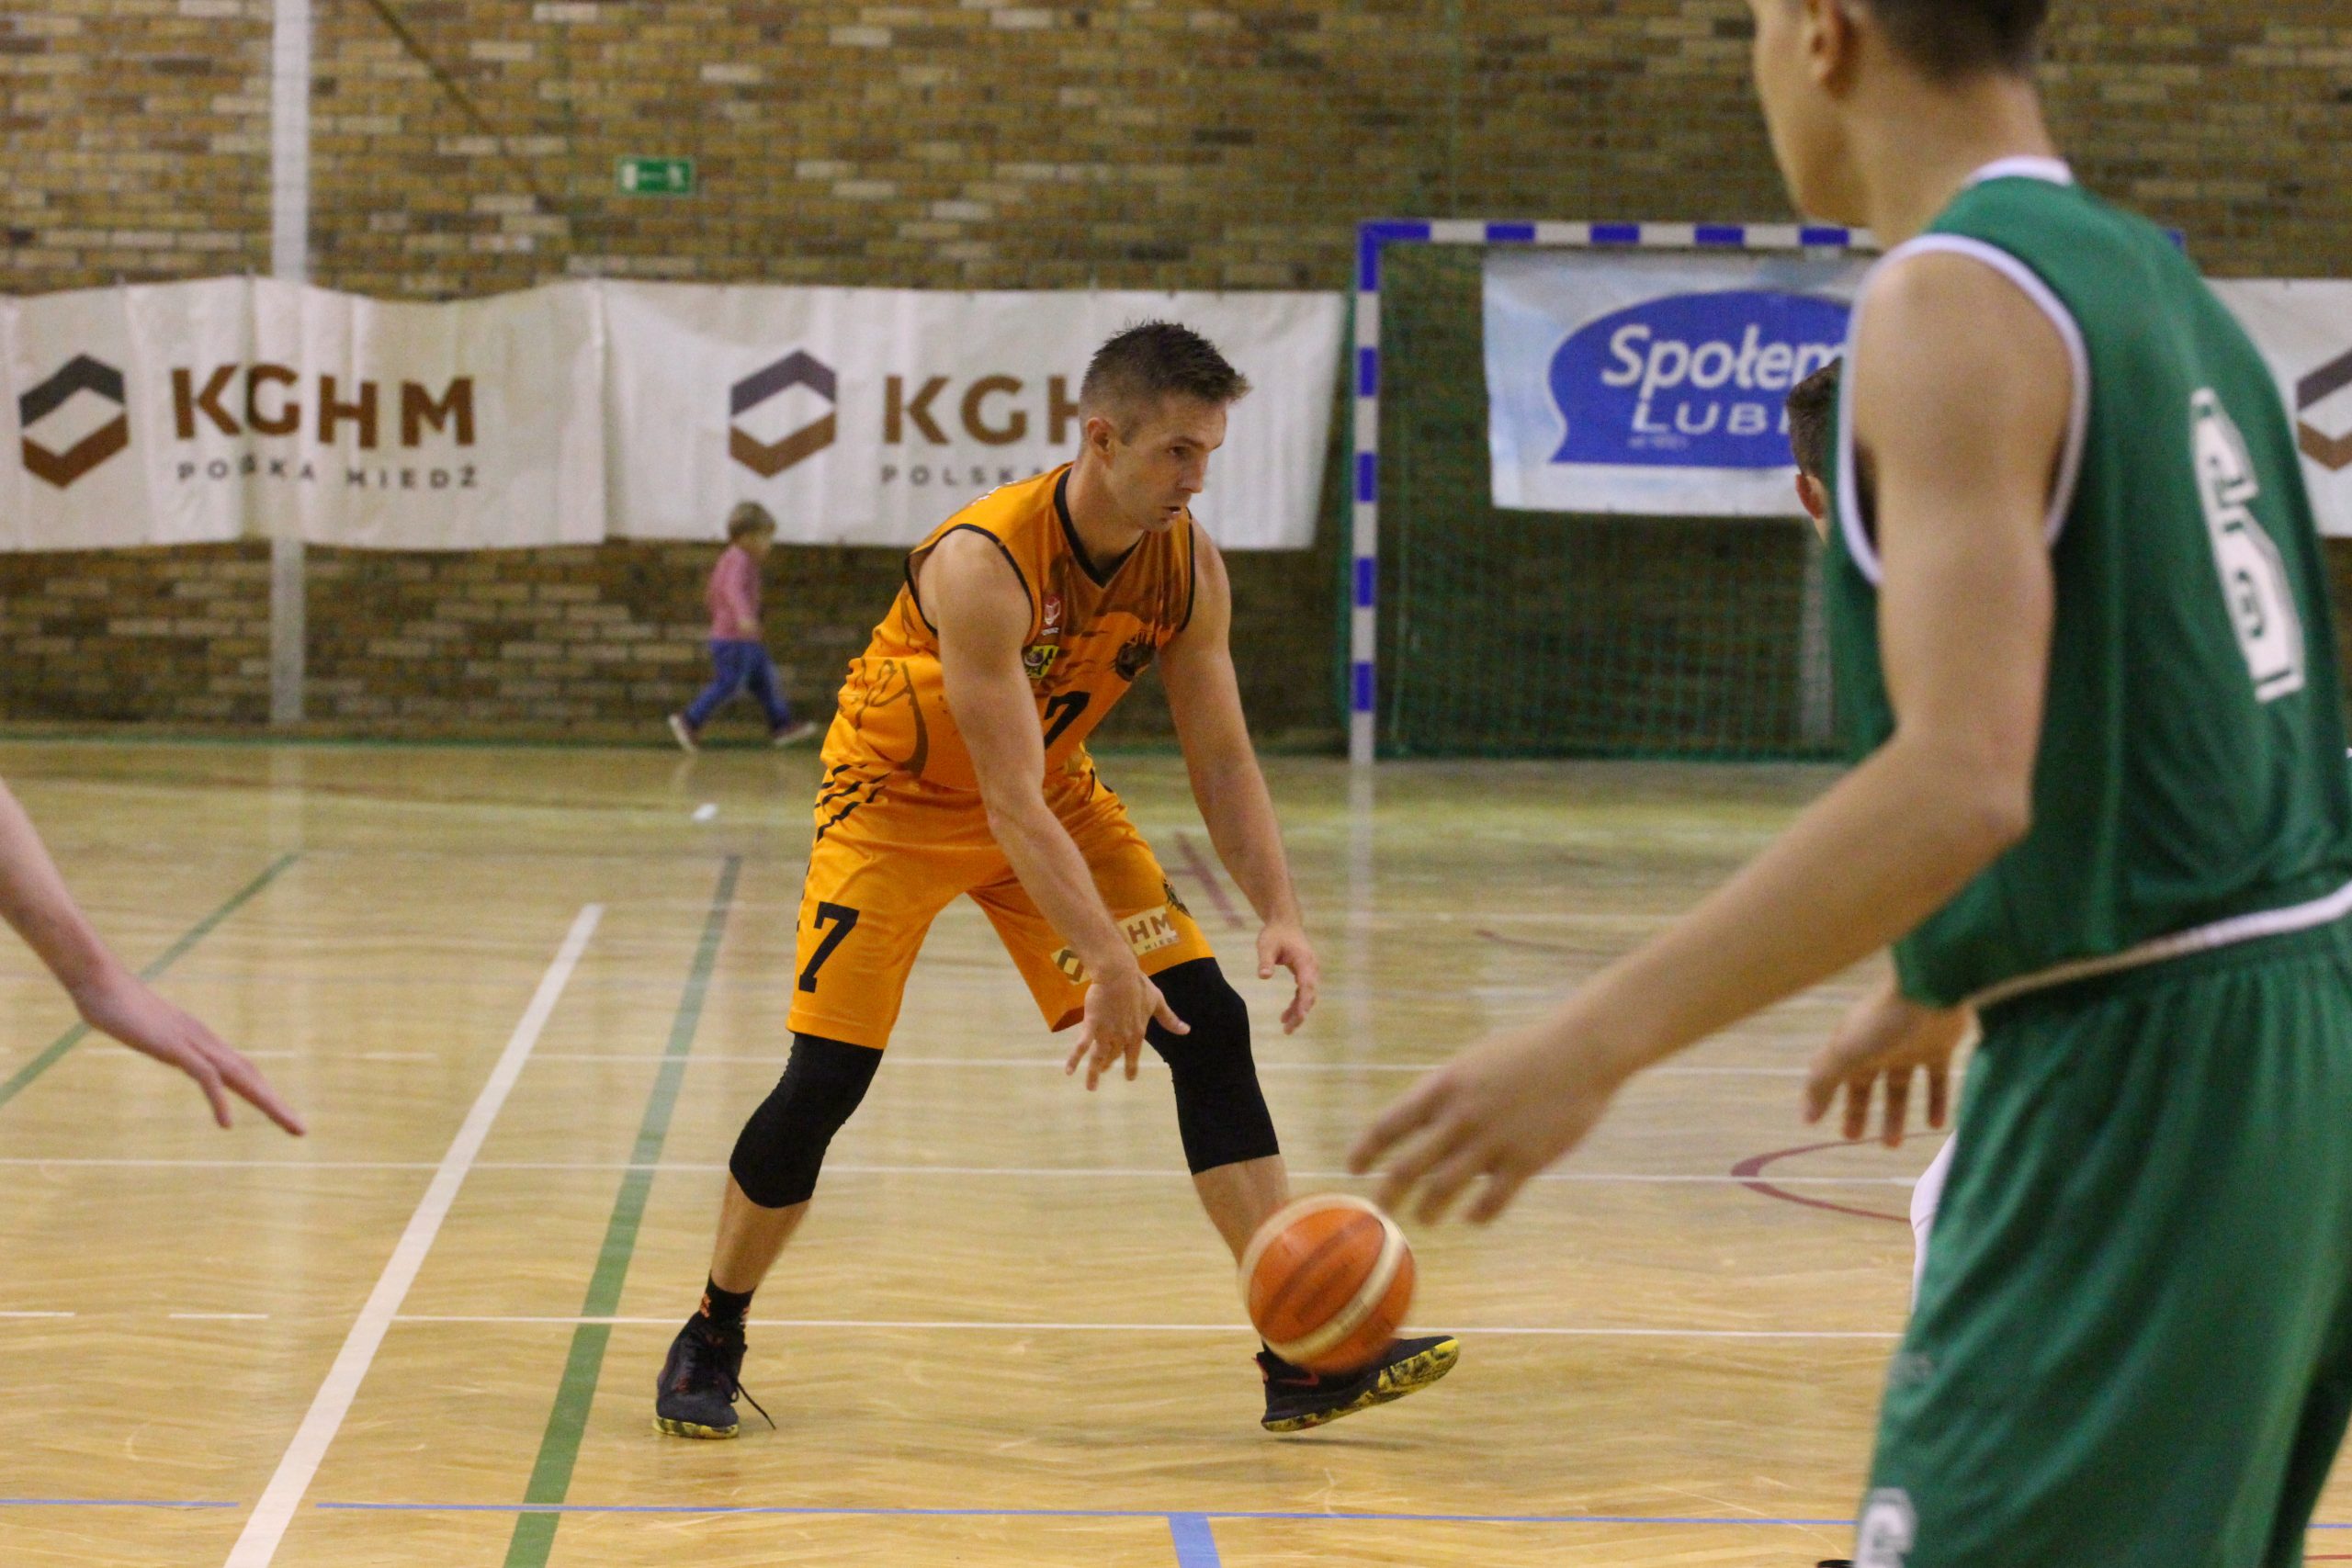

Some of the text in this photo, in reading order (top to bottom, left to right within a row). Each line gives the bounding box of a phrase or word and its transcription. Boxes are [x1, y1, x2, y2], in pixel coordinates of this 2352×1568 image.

[171, 363, 475, 449] KGHM
[883, 375, 1079, 446] KGH
[1632, 400, 1790, 435] LUBI
[2189, 386, 2305, 702] 6
[798, 901, 860, 994] 7
[1127, 913, 1176, 944] HM
